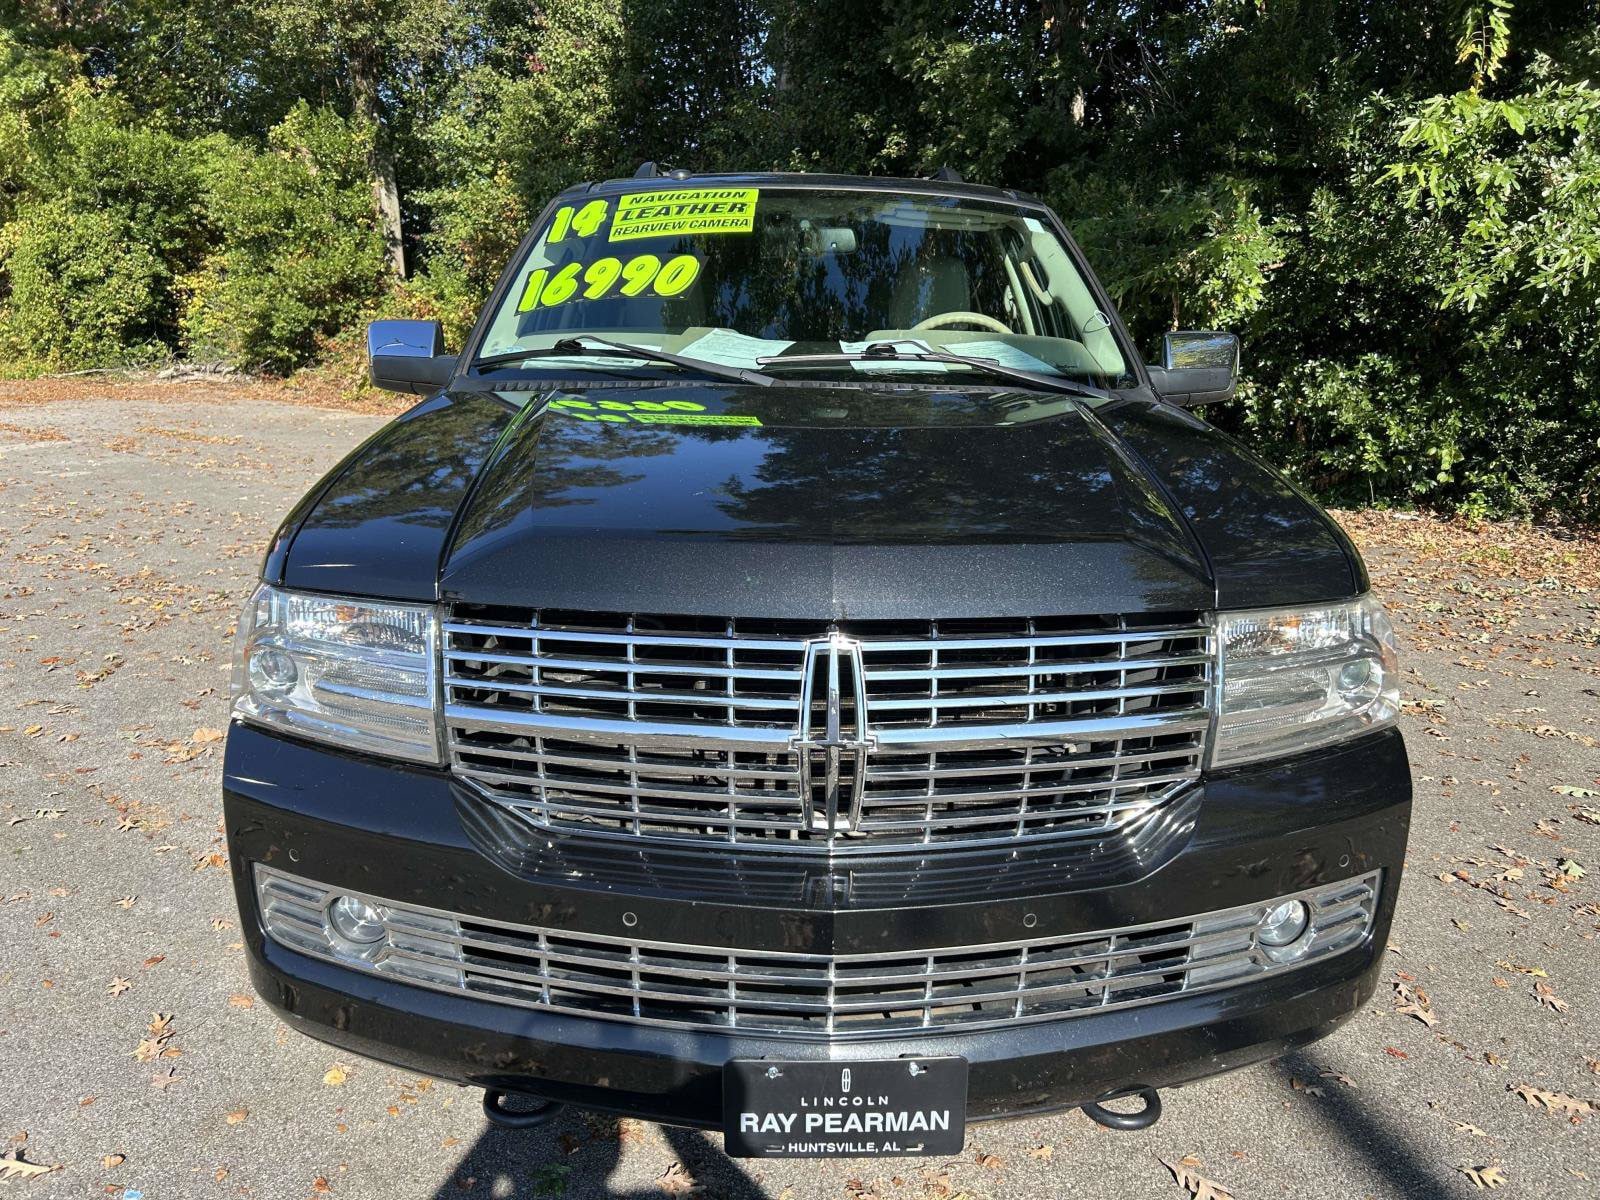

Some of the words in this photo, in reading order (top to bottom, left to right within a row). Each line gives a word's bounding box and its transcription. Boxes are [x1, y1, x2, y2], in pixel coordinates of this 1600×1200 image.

[629, 191, 748, 205] NAVIGATION
[546, 200, 608, 243] 14
[620, 202, 749, 222] LEATHER
[612, 221, 686, 238] REARVIEW
[689, 218, 750, 229] CAMERA
[516, 254, 700, 313] 16990
[800, 1095, 889, 1107] LINCOLN
[740, 1112, 797, 1133] RAY
[805, 1110, 950, 1133] PEARMAN
[788, 1142, 879, 1154] HUNTSVILLE,
[882, 1141, 901, 1152] AL
